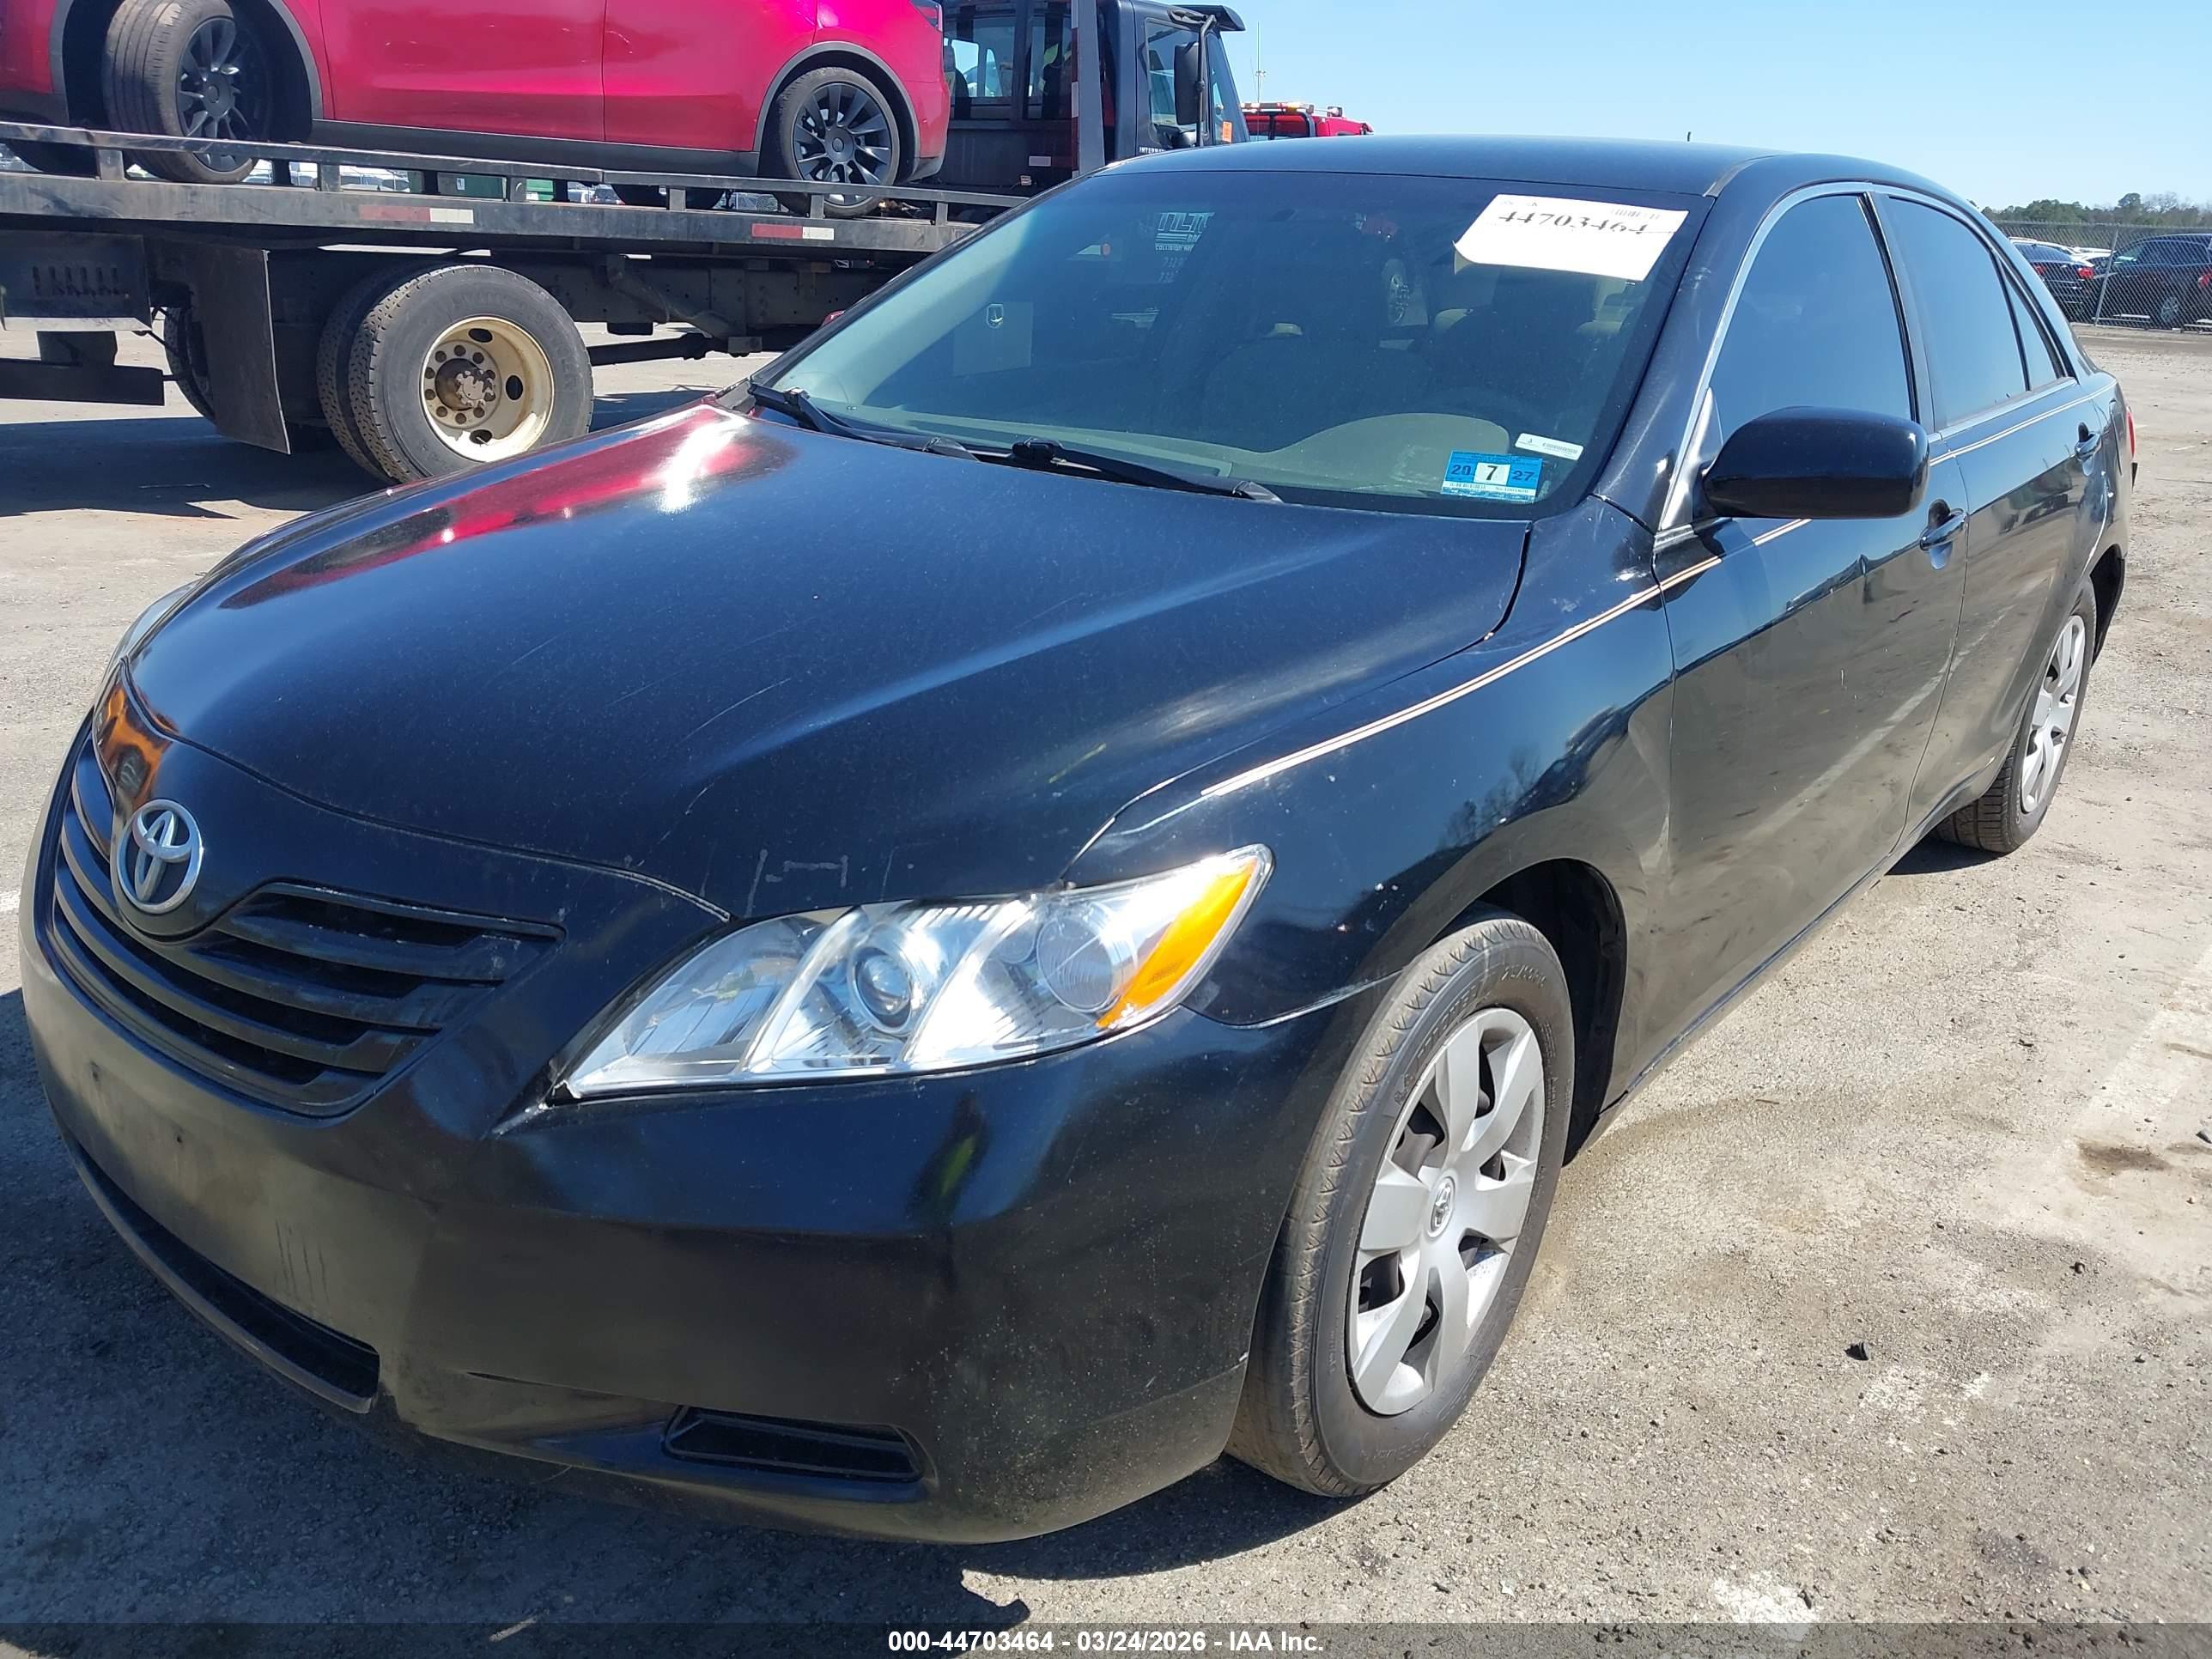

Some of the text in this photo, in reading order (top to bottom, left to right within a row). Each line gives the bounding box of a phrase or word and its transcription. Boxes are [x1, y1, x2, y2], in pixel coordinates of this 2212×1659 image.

[1498, 210, 1649, 234] 44703464
[1486, 465, 1498, 481] 7
[1512, 470, 1534, 482] 27
